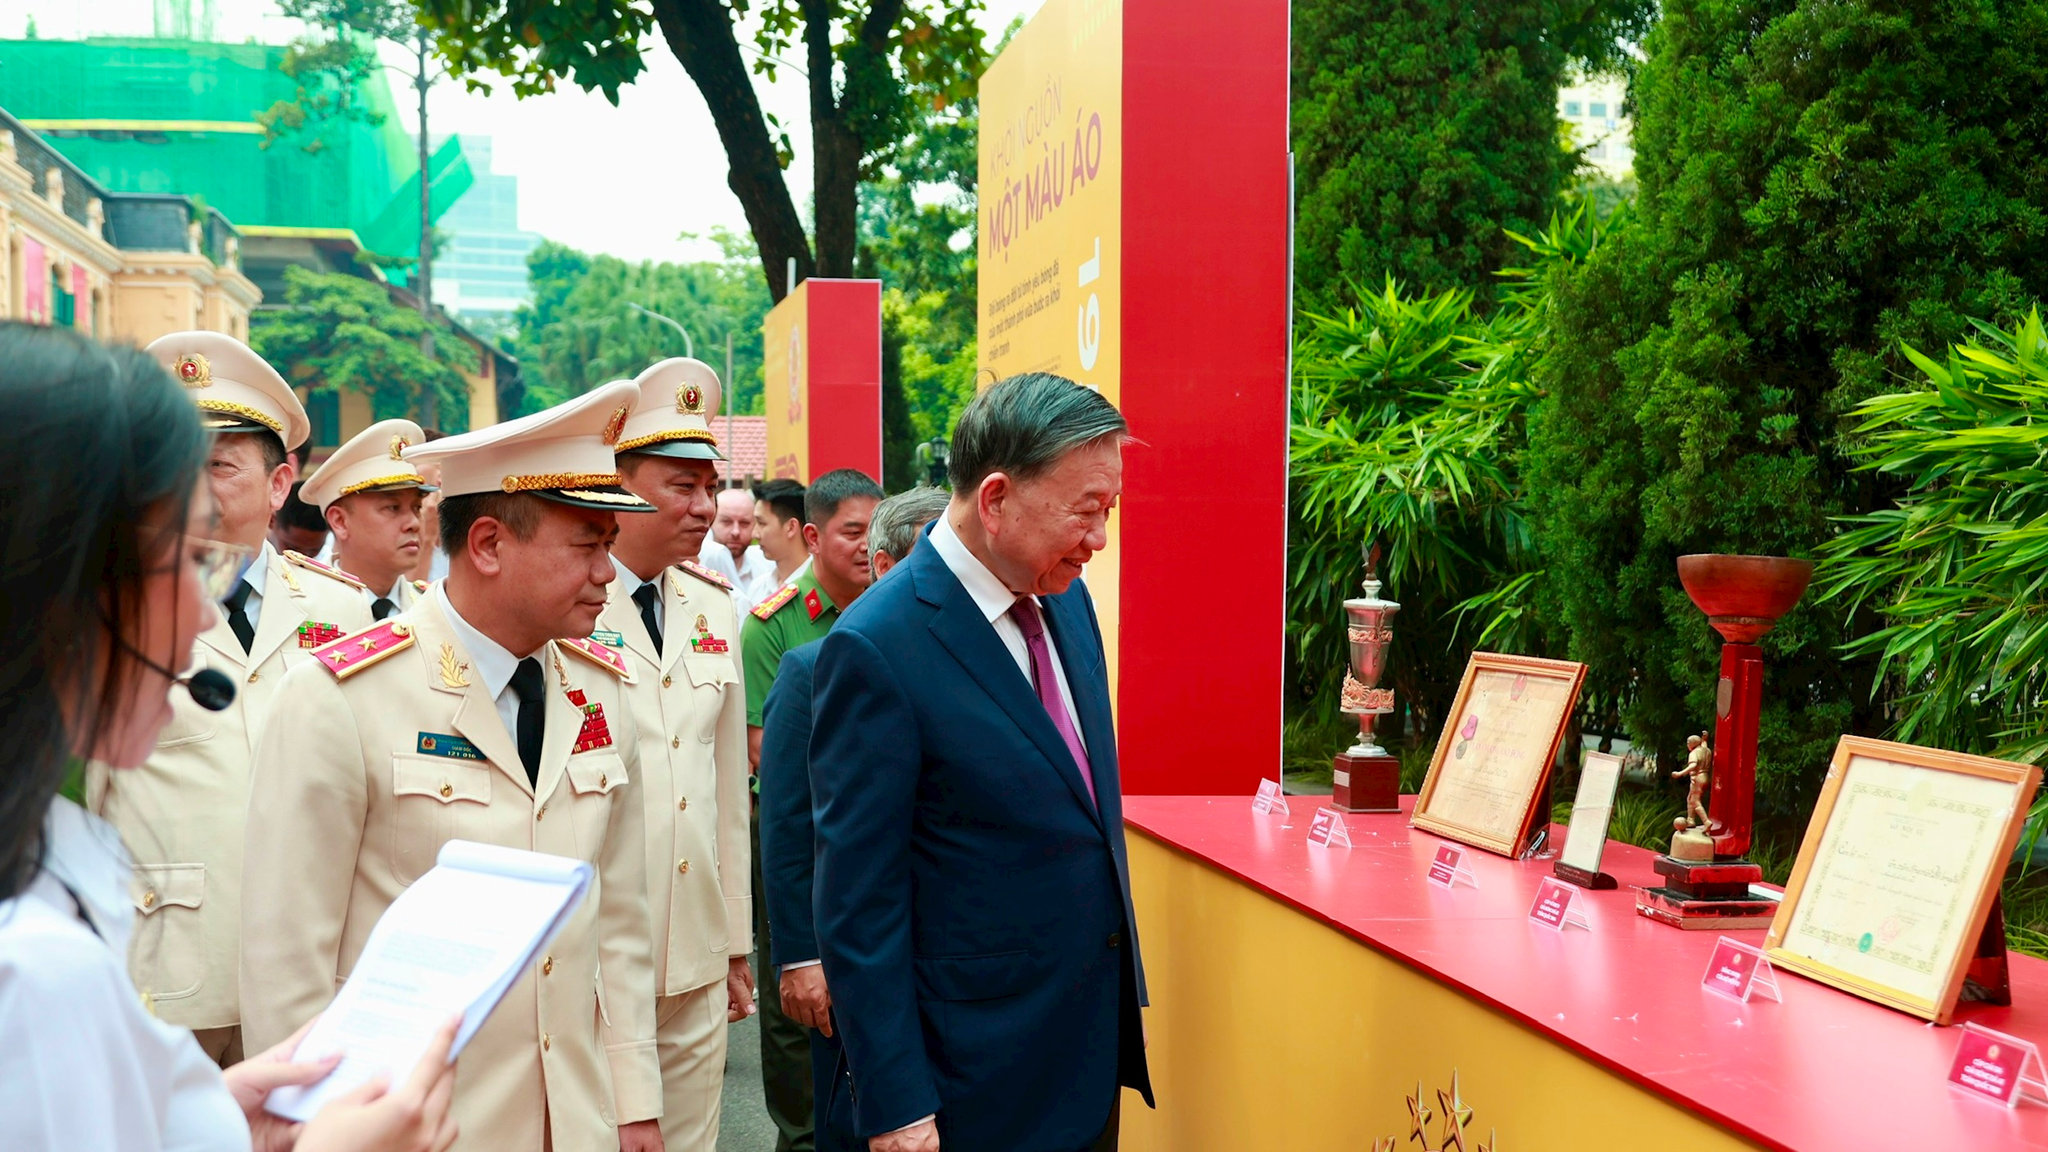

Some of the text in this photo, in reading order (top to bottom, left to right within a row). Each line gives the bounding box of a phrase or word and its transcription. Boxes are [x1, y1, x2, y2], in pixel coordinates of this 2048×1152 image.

[1018, 73, 1062, 149] NGUỒN
[989, 107, 1101, 264] MỘT MÀU ÁO
